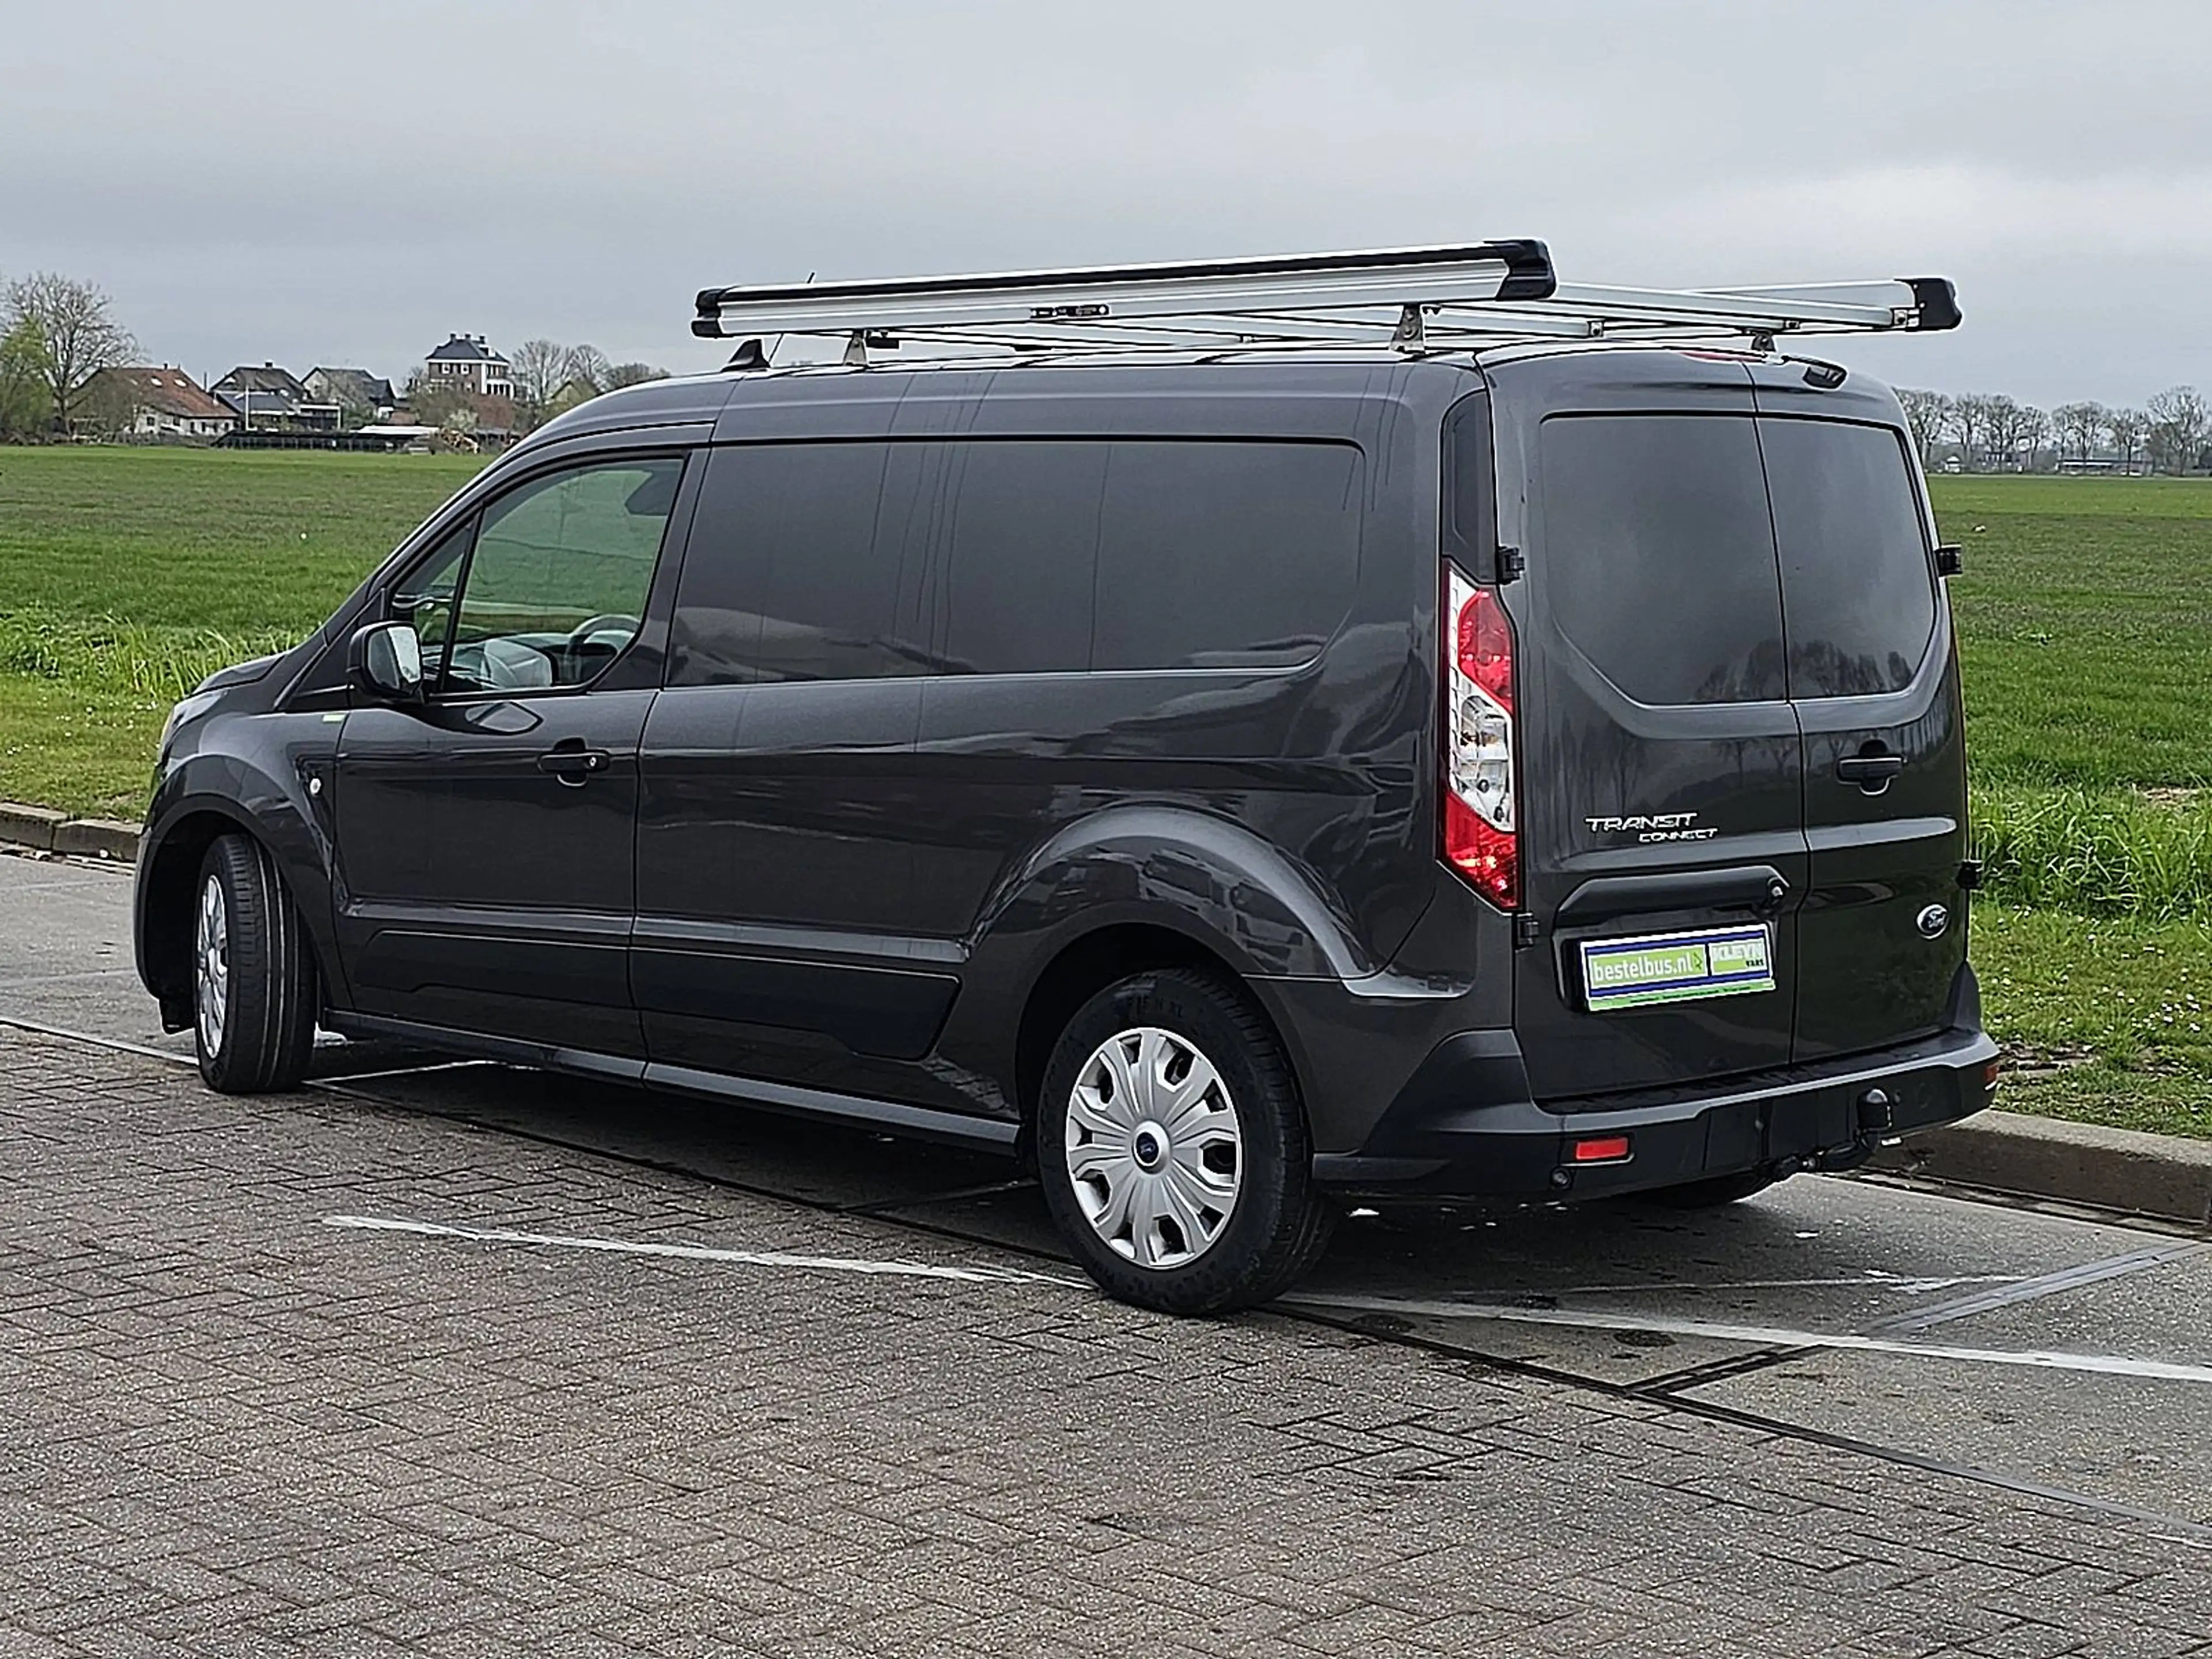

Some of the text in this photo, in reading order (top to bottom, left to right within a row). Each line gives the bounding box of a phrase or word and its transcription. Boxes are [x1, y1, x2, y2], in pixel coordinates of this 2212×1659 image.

[1585, 812, 1697, 831] TRANSIT
[1639, 828, 1718, 843] CONNECT
[1593, 951, 1694, 982] bestelbus.nl
